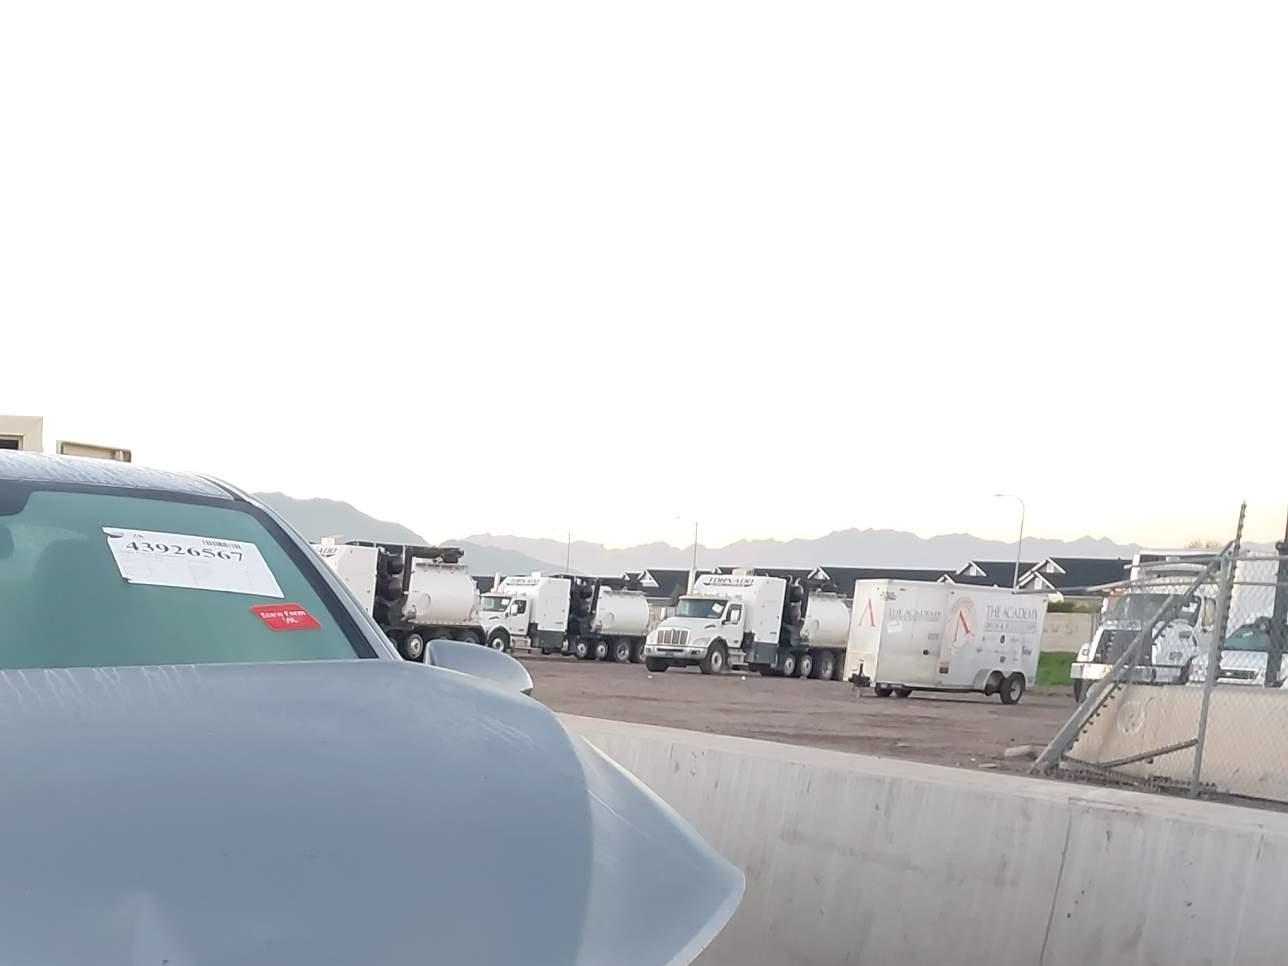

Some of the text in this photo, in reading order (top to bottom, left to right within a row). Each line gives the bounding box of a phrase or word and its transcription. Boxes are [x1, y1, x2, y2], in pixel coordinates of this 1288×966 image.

[126, 541, 243, 562] 43926567
[986, 605, 1038, 619] THE ACADEMY
